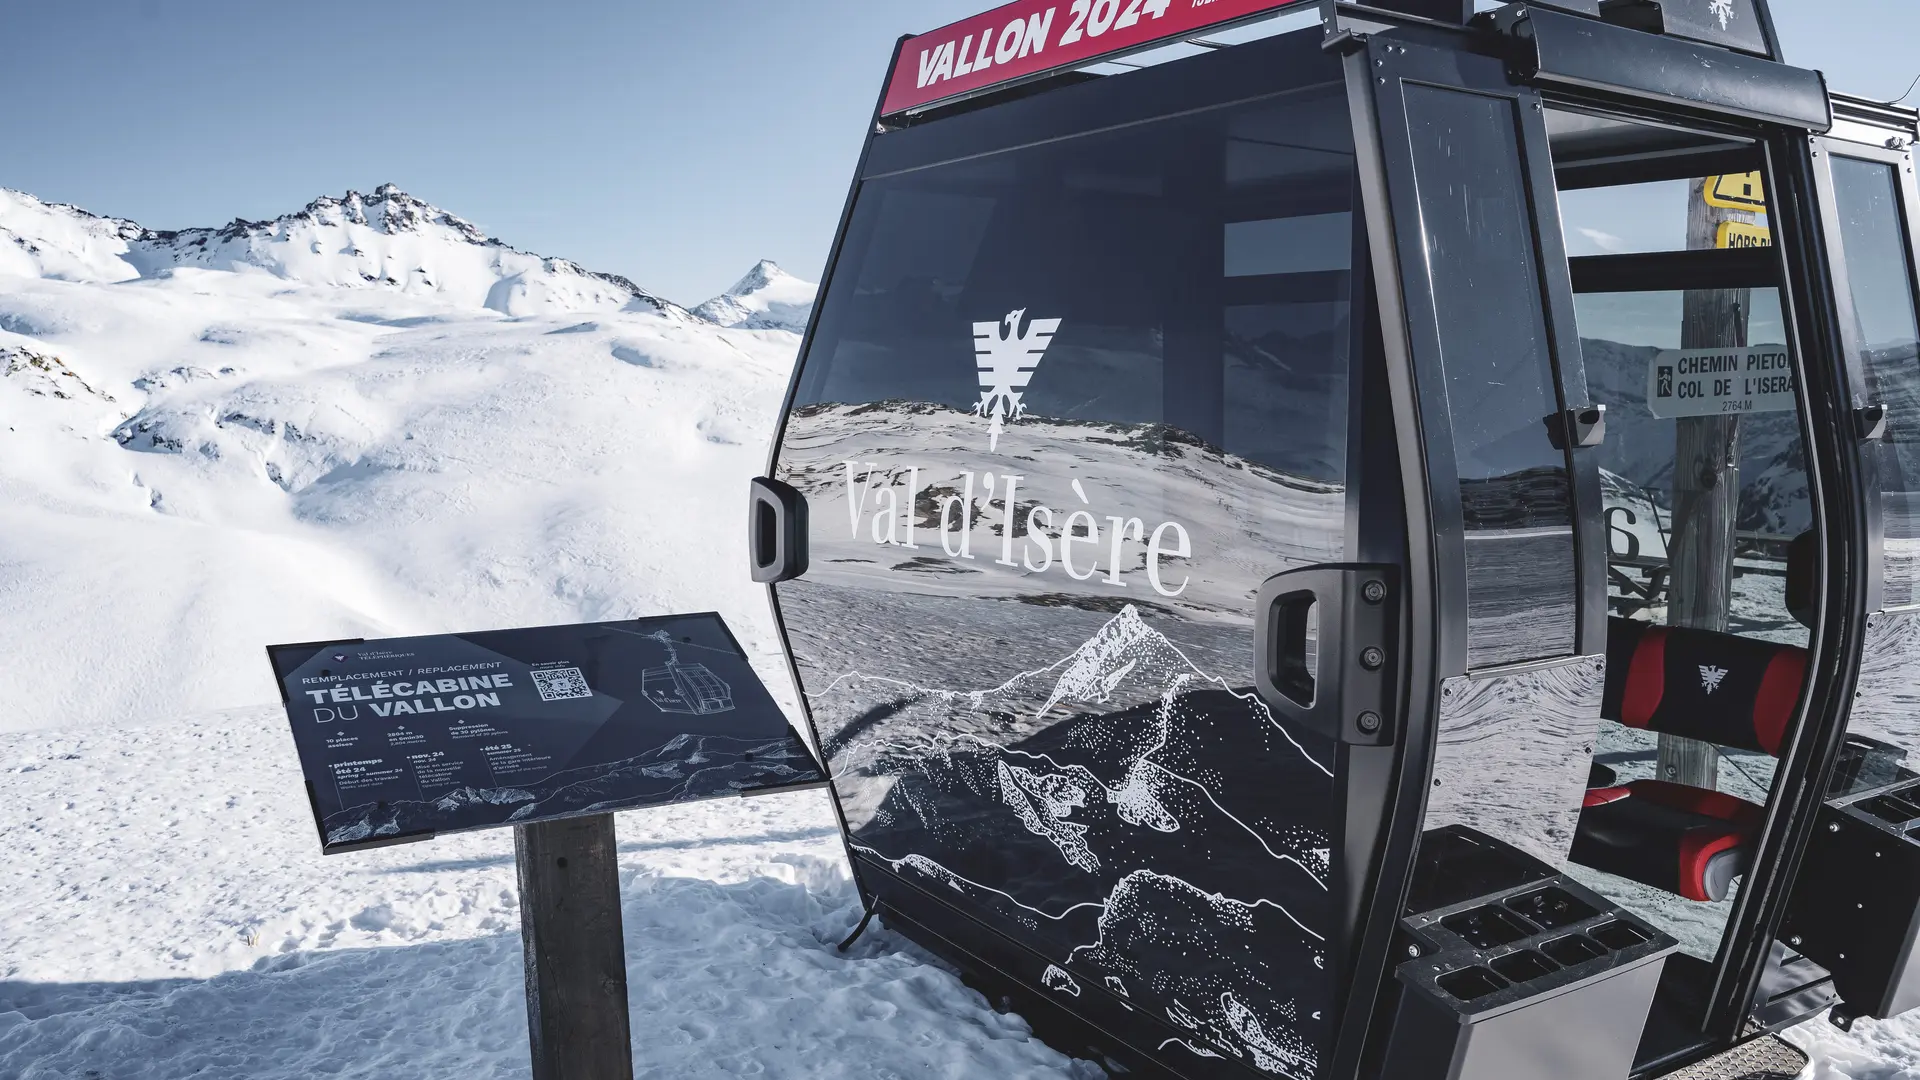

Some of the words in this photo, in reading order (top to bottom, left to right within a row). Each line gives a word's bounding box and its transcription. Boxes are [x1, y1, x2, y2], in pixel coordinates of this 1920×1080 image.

[916, 7, 1056, 88] VALLON
[1059, 0, 1170, 47] 2024
[1678, 355, 1738, 375] CHEMIN
[1747, 353, 1791, 371] PIETO
[1678, 381, 1704, 399] COL
[1714, 379, 1732, 397] DE
[1745, 376, 1794, 395] L'ISERA
[842, 460, 919, 549] Val
[302, 670, 404, 684] REMPLACEMENT
[417, 661, 502, 675] REPLACEMENT
[305, 673, 514, 704] TÉLÉCABINE
[313, 705, 359, 723] DU
[368, 692, 501, 717] VALLON
[333, 758, 383, 769] printemps
